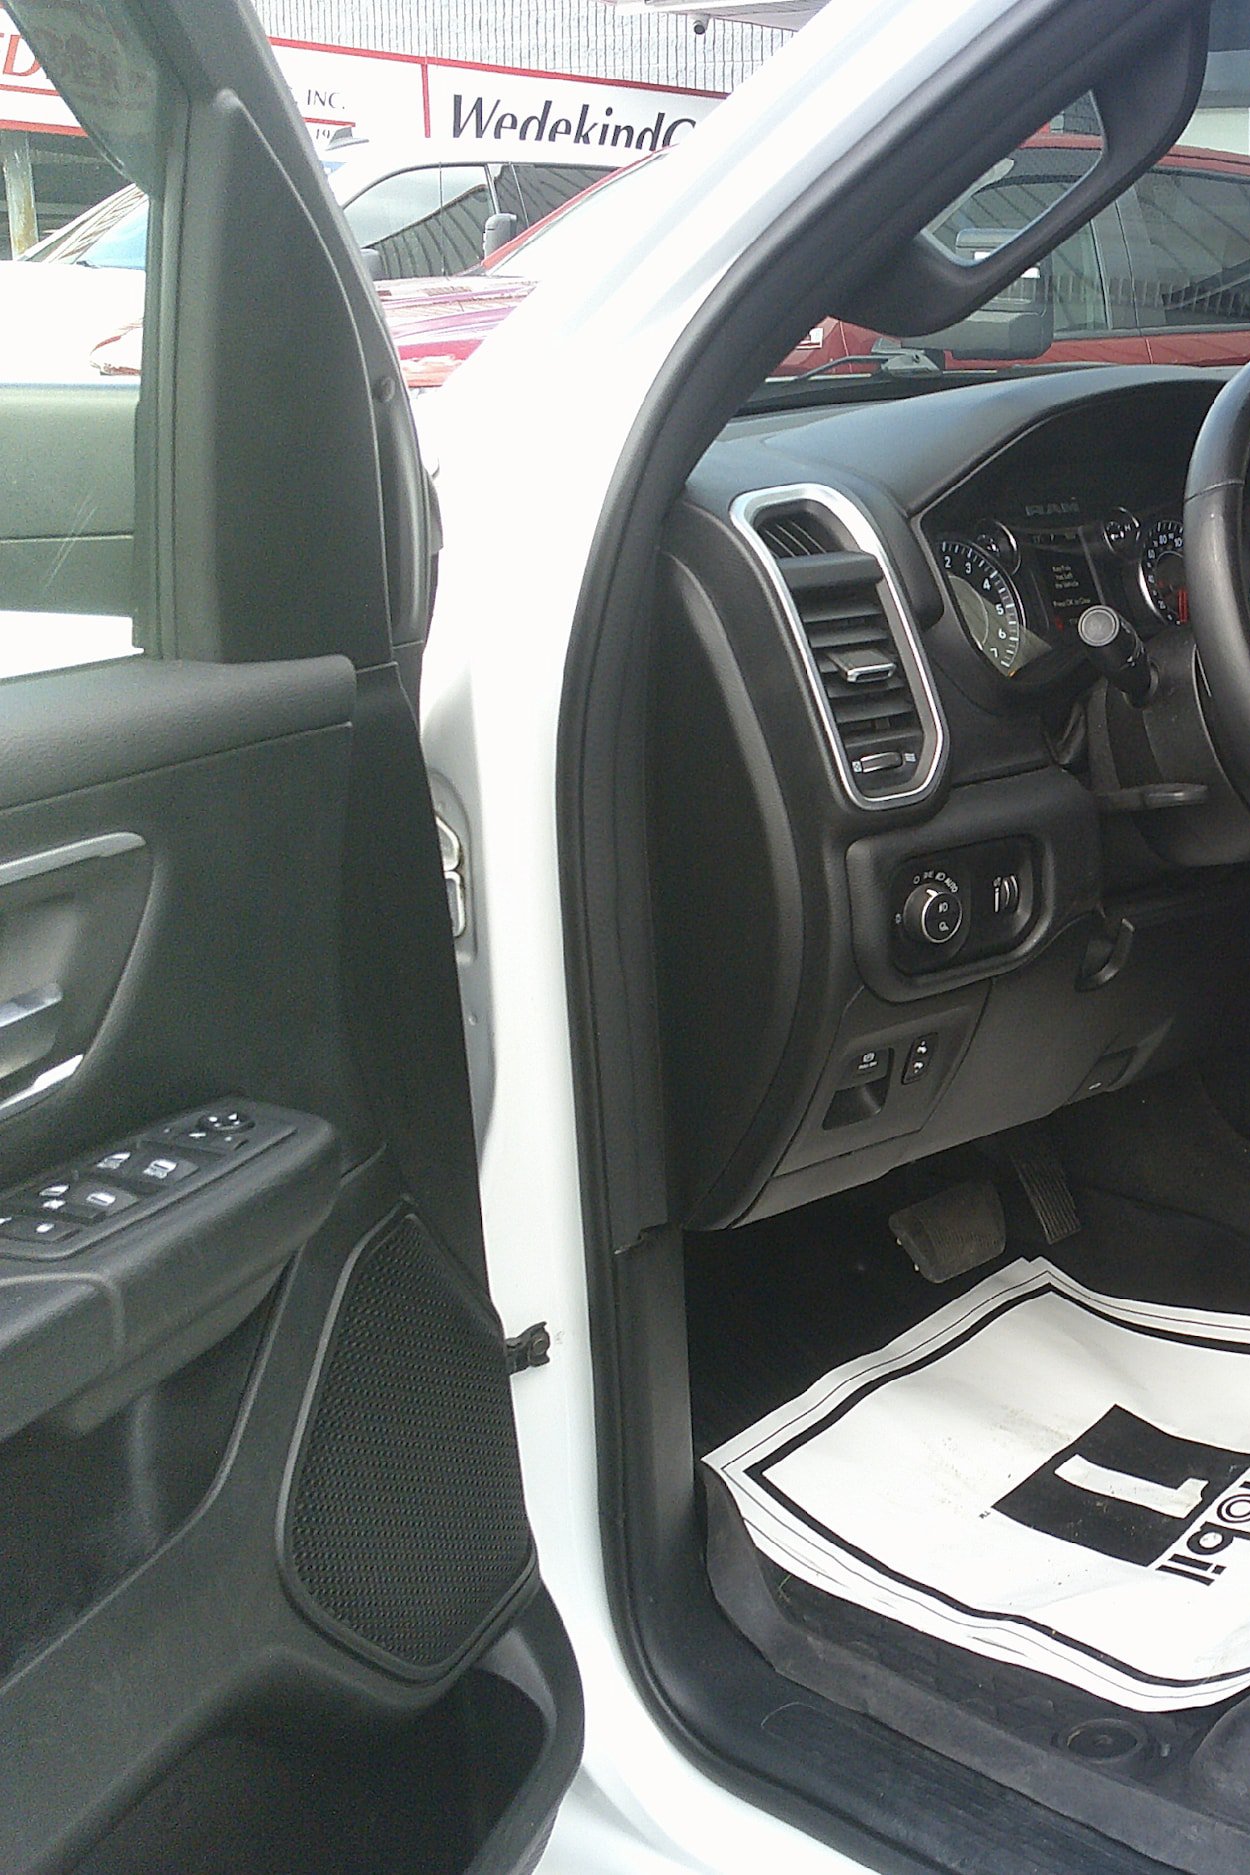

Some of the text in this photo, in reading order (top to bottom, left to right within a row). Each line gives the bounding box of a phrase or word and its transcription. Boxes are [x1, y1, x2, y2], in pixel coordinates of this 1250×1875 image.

[0, 33, 41, 76] D
[306, 88, 345, 109] INC.
[944, 556, 952, 568] 2
[965, 562, 972, 574] 3
[983, 578, 991, 591] 4
[996, 603, 1004, 615] 5
[998, 628, 1006, 639] 6
[990, 647, 998, 658] 7
[944, 877, 959, 893] AUTO
